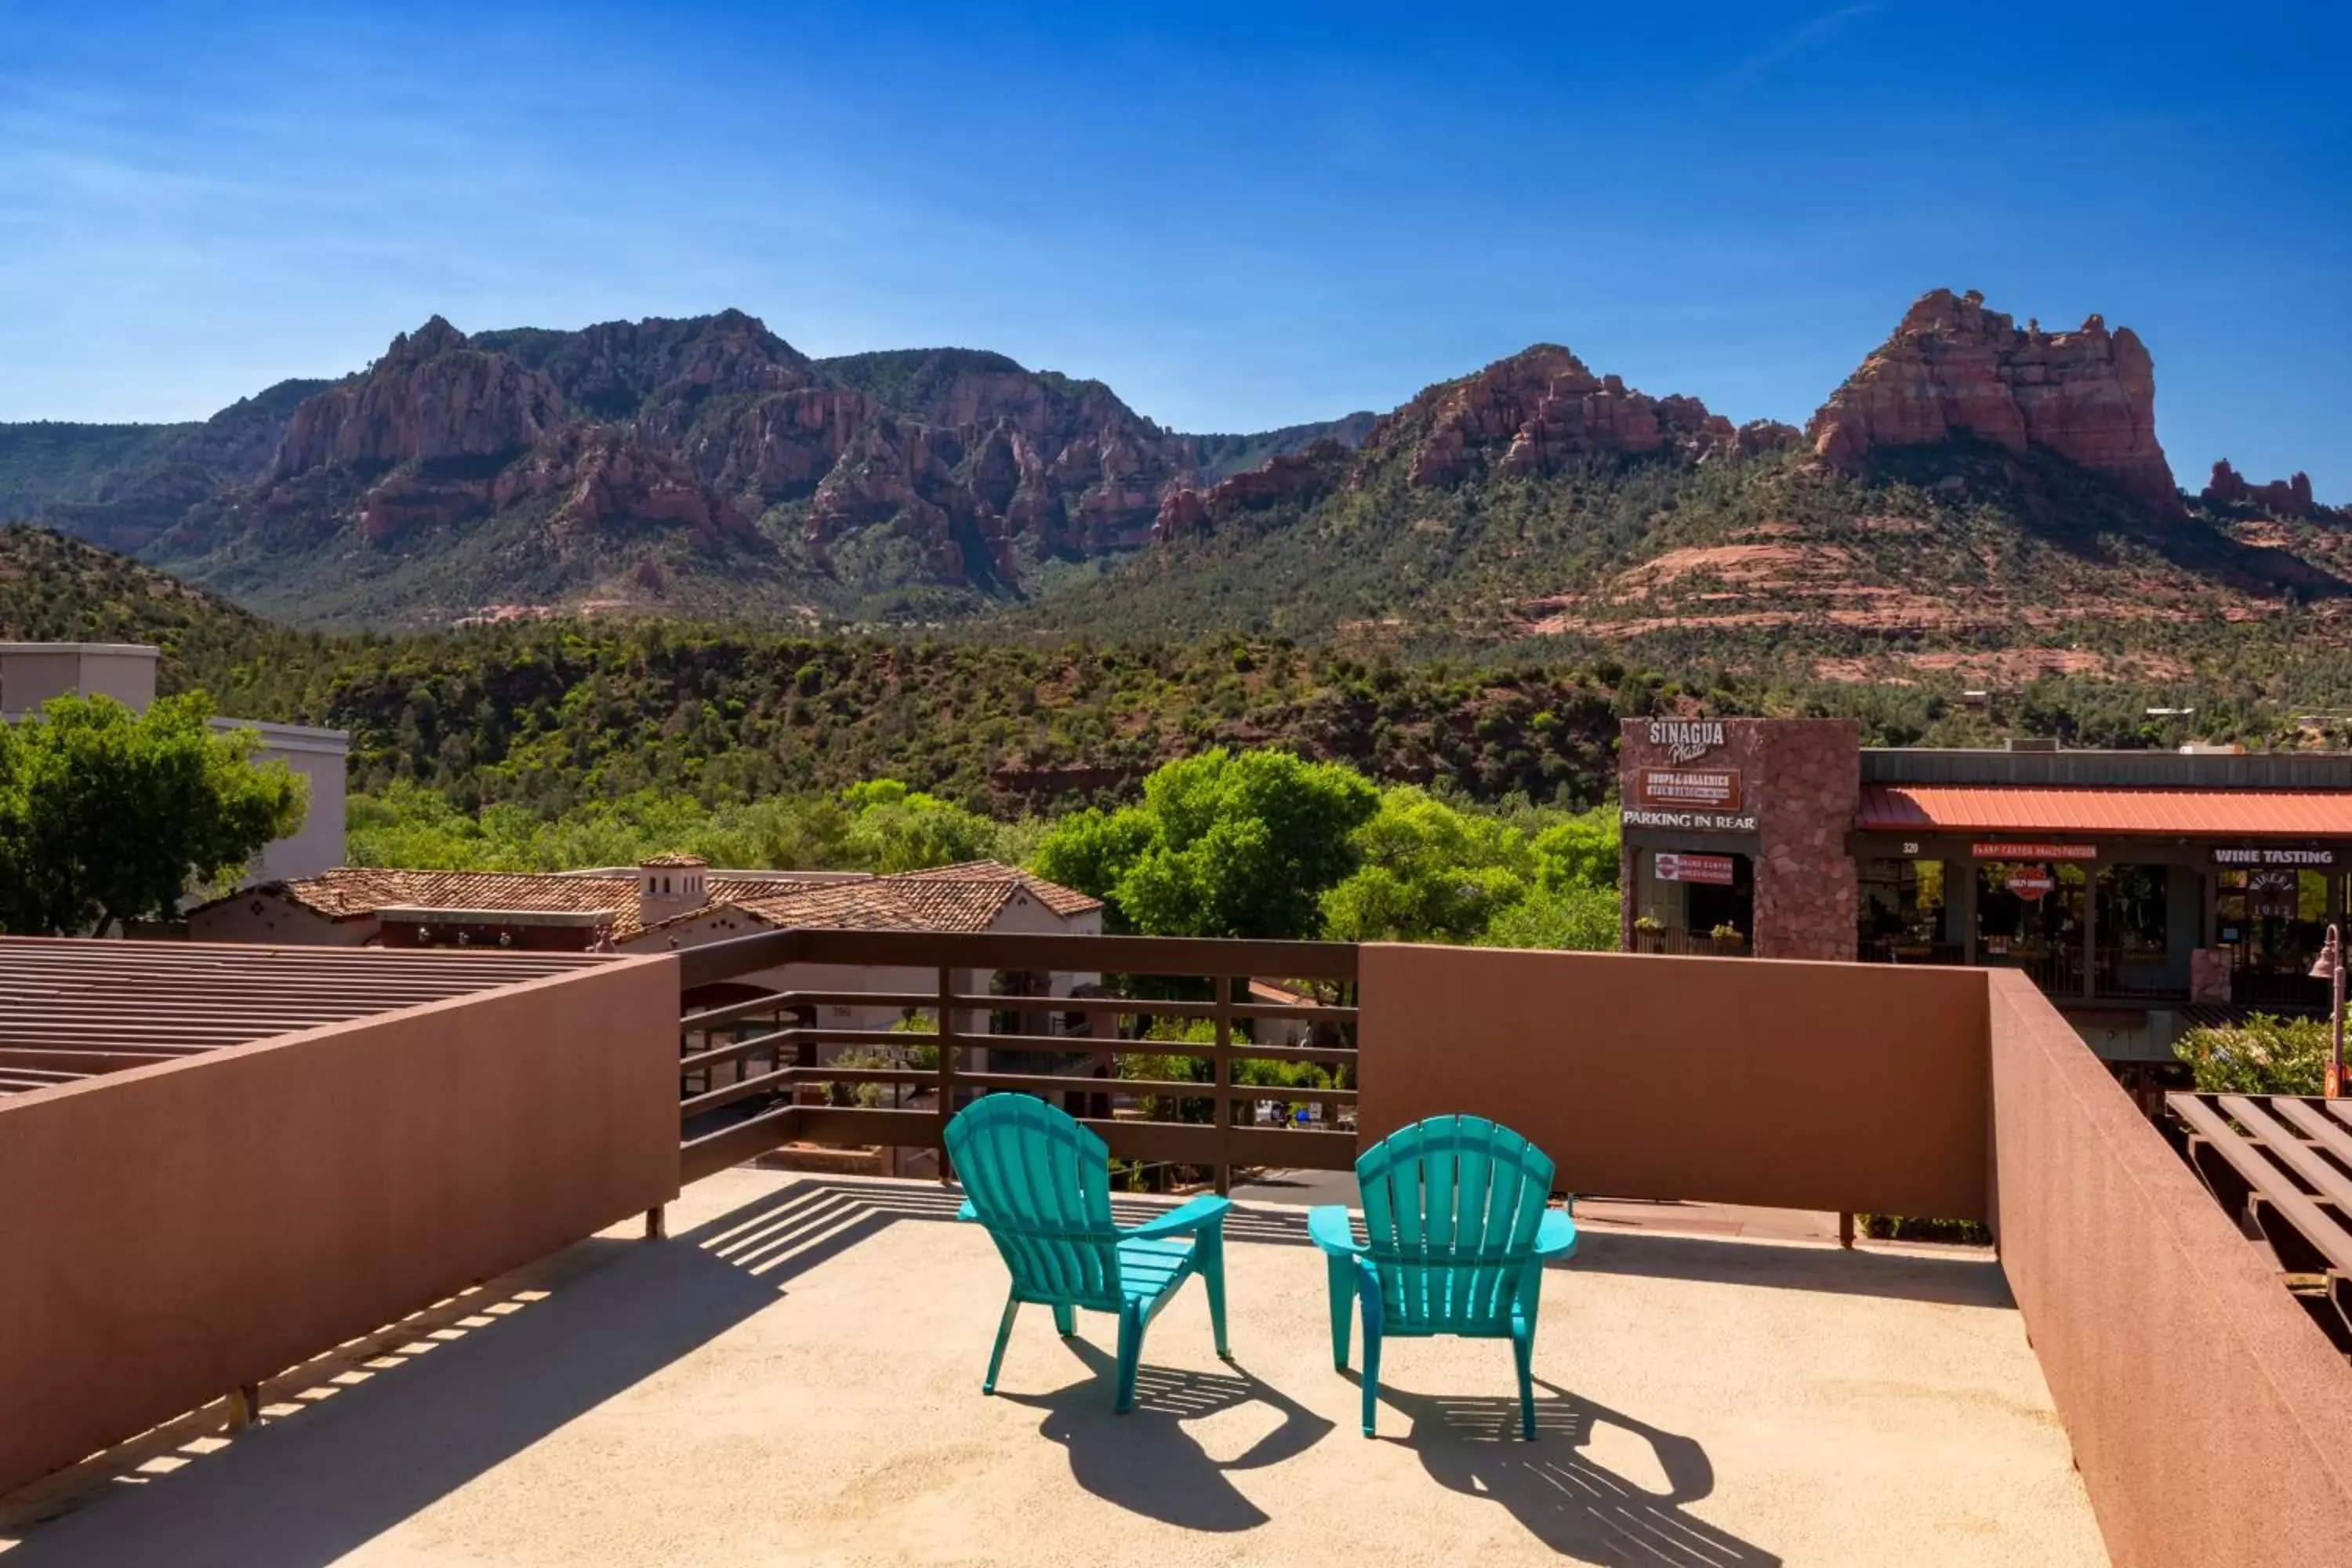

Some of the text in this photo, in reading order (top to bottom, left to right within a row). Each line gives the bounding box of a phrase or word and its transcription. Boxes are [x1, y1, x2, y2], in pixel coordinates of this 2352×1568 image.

[1650, 722, 1724, 745] SINAGUA
[1668, 742, 1708, 764] Plaza
[1623, 811, 1755, 829] PARKING IN REAR
[2215, 849, 2333, 863] WINE TASTING
